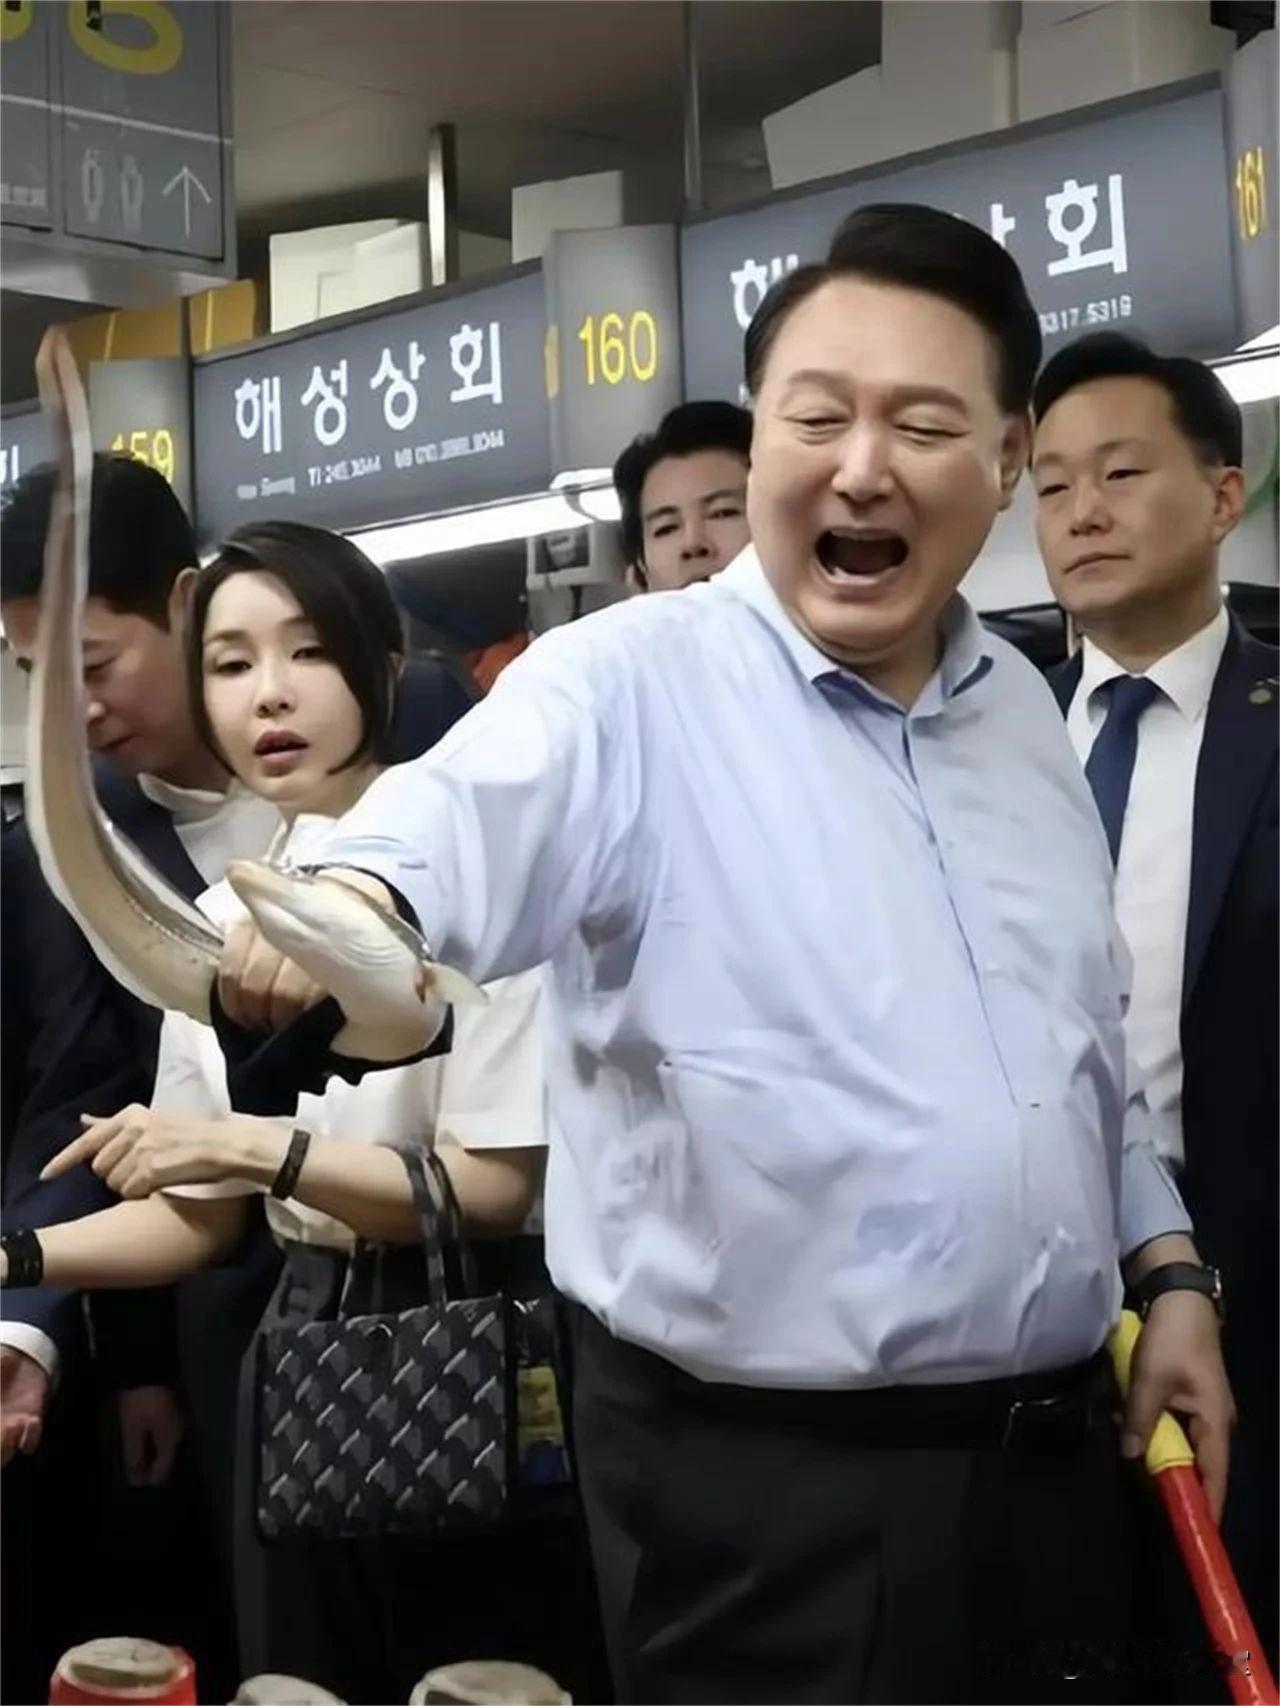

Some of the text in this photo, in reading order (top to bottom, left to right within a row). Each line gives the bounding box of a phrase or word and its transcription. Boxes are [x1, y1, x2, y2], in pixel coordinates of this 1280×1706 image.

[1236, 146, 1266, 241] 161
[234, 321, 502, 453] 해성상회
[578, 309, 656, 385] 160
